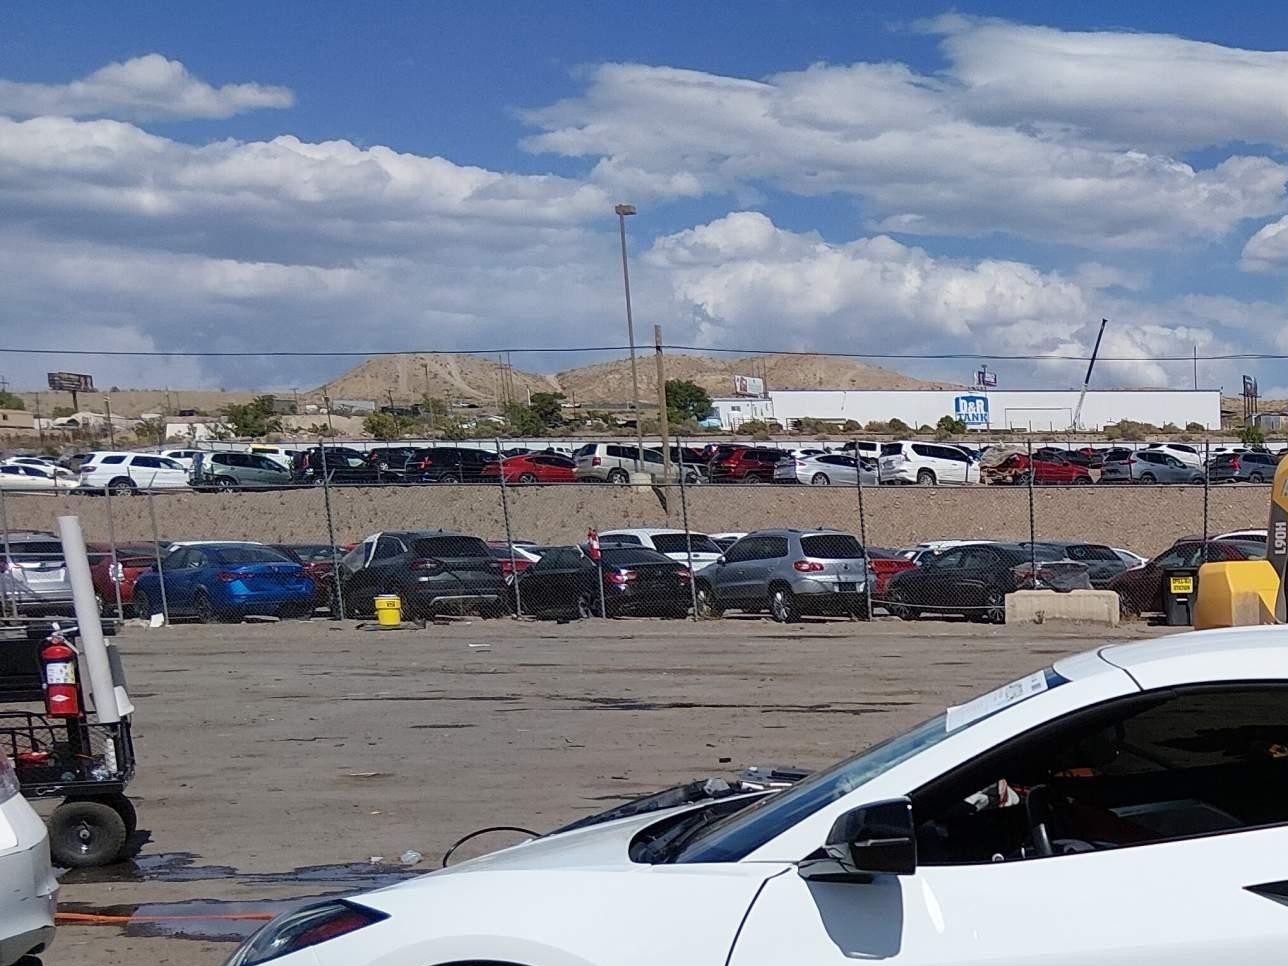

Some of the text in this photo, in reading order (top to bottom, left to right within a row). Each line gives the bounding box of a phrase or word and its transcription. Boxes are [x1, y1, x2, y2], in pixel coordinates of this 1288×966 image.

[959, 398, 985, 412] D&R
[958, 413, 988, 422] TANK
[1274, 521, 1287, 555] L90H
